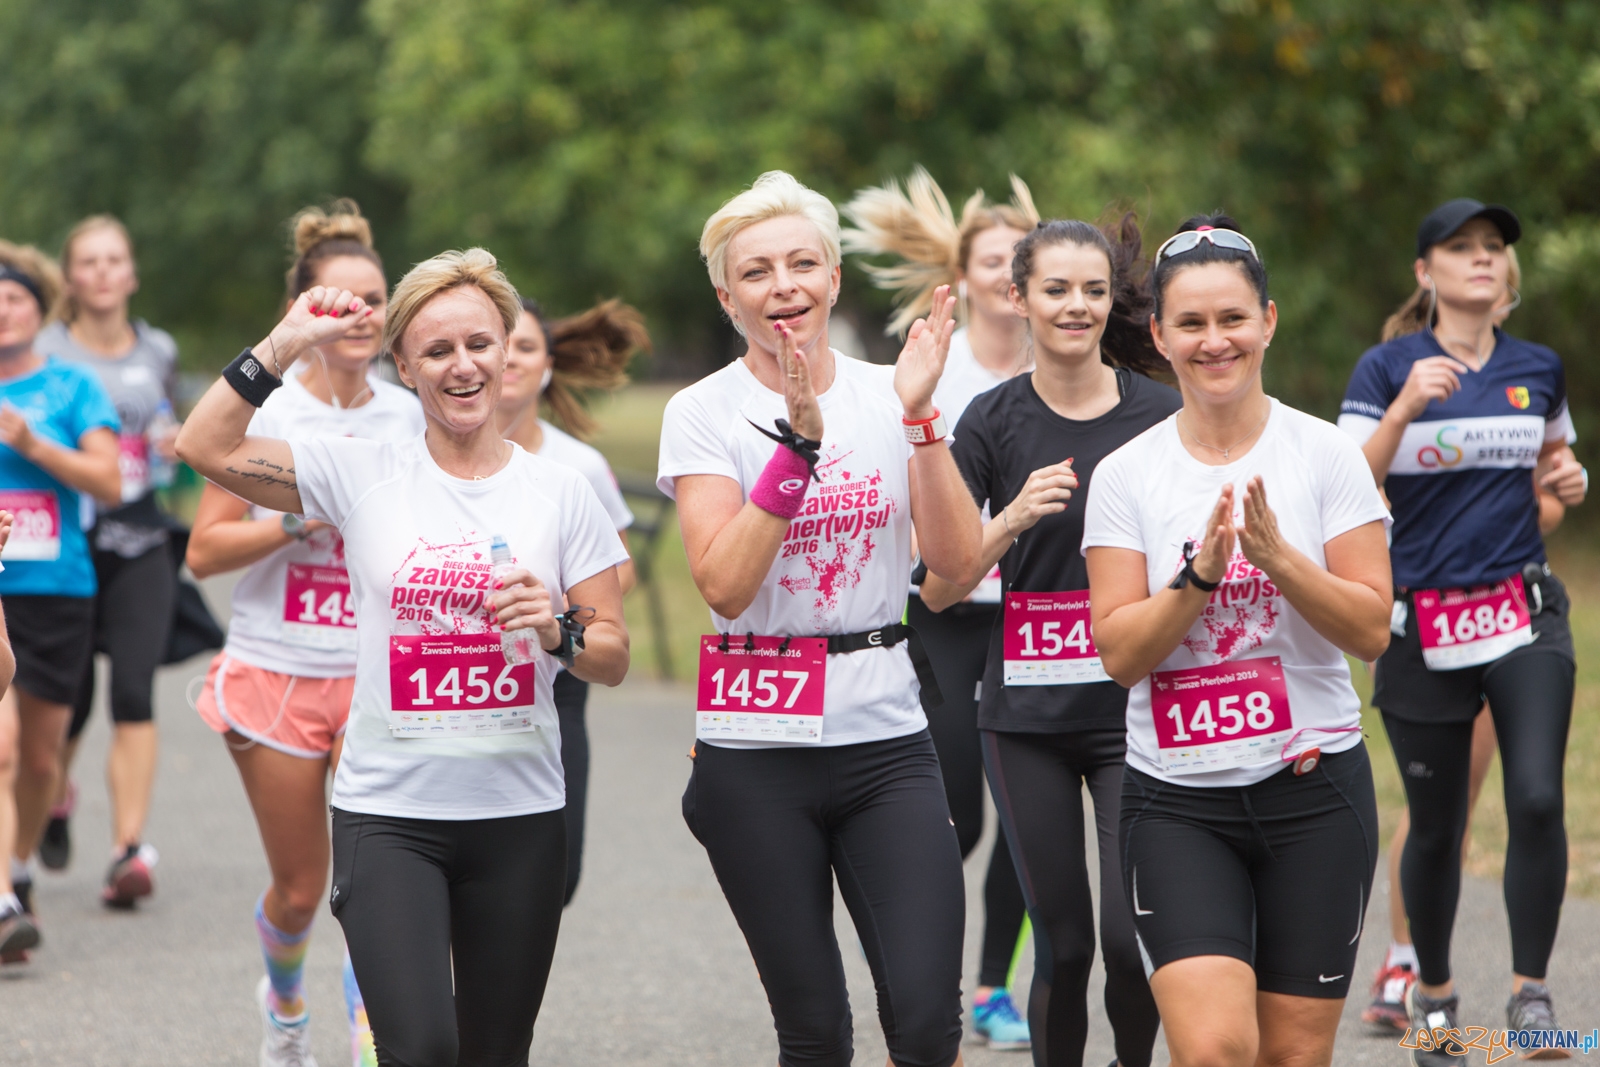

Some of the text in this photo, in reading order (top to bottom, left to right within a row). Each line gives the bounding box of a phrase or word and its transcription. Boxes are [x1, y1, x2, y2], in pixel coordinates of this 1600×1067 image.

[820, 481, 867, 495] BIEG KOBIET
[782, 539, 818, 559] 2016
[442, 561, 494, 572] BIEG KOBIE
[408, 567, 490, 591] zawsz
[299, 588, 357, 626] 145
[391, 587, 485, 616] pier(w)
[1027, 602, 1053, 611] Zawsze
[1053, 600, 1085, 611] Pier(w)si
[396, 606, 434, 622] 2016
[1432, 598, 1518, 646] 1686
[421, 646, 453, 656] Zawsze
[453, 644, 489, 655] Pier(w)si
[1018, 619, 1098, 657] 154
[408, 664, 519, 705] 1456
[710, 668, 809, 709] 1457
[1173, 680, 1200, 691] Zawsze
[1200, 674, 1236, 688] Pier(w)si
[1236, 670, 1259, 681] 2016
[1166, 690, 1275, 742] 1458
